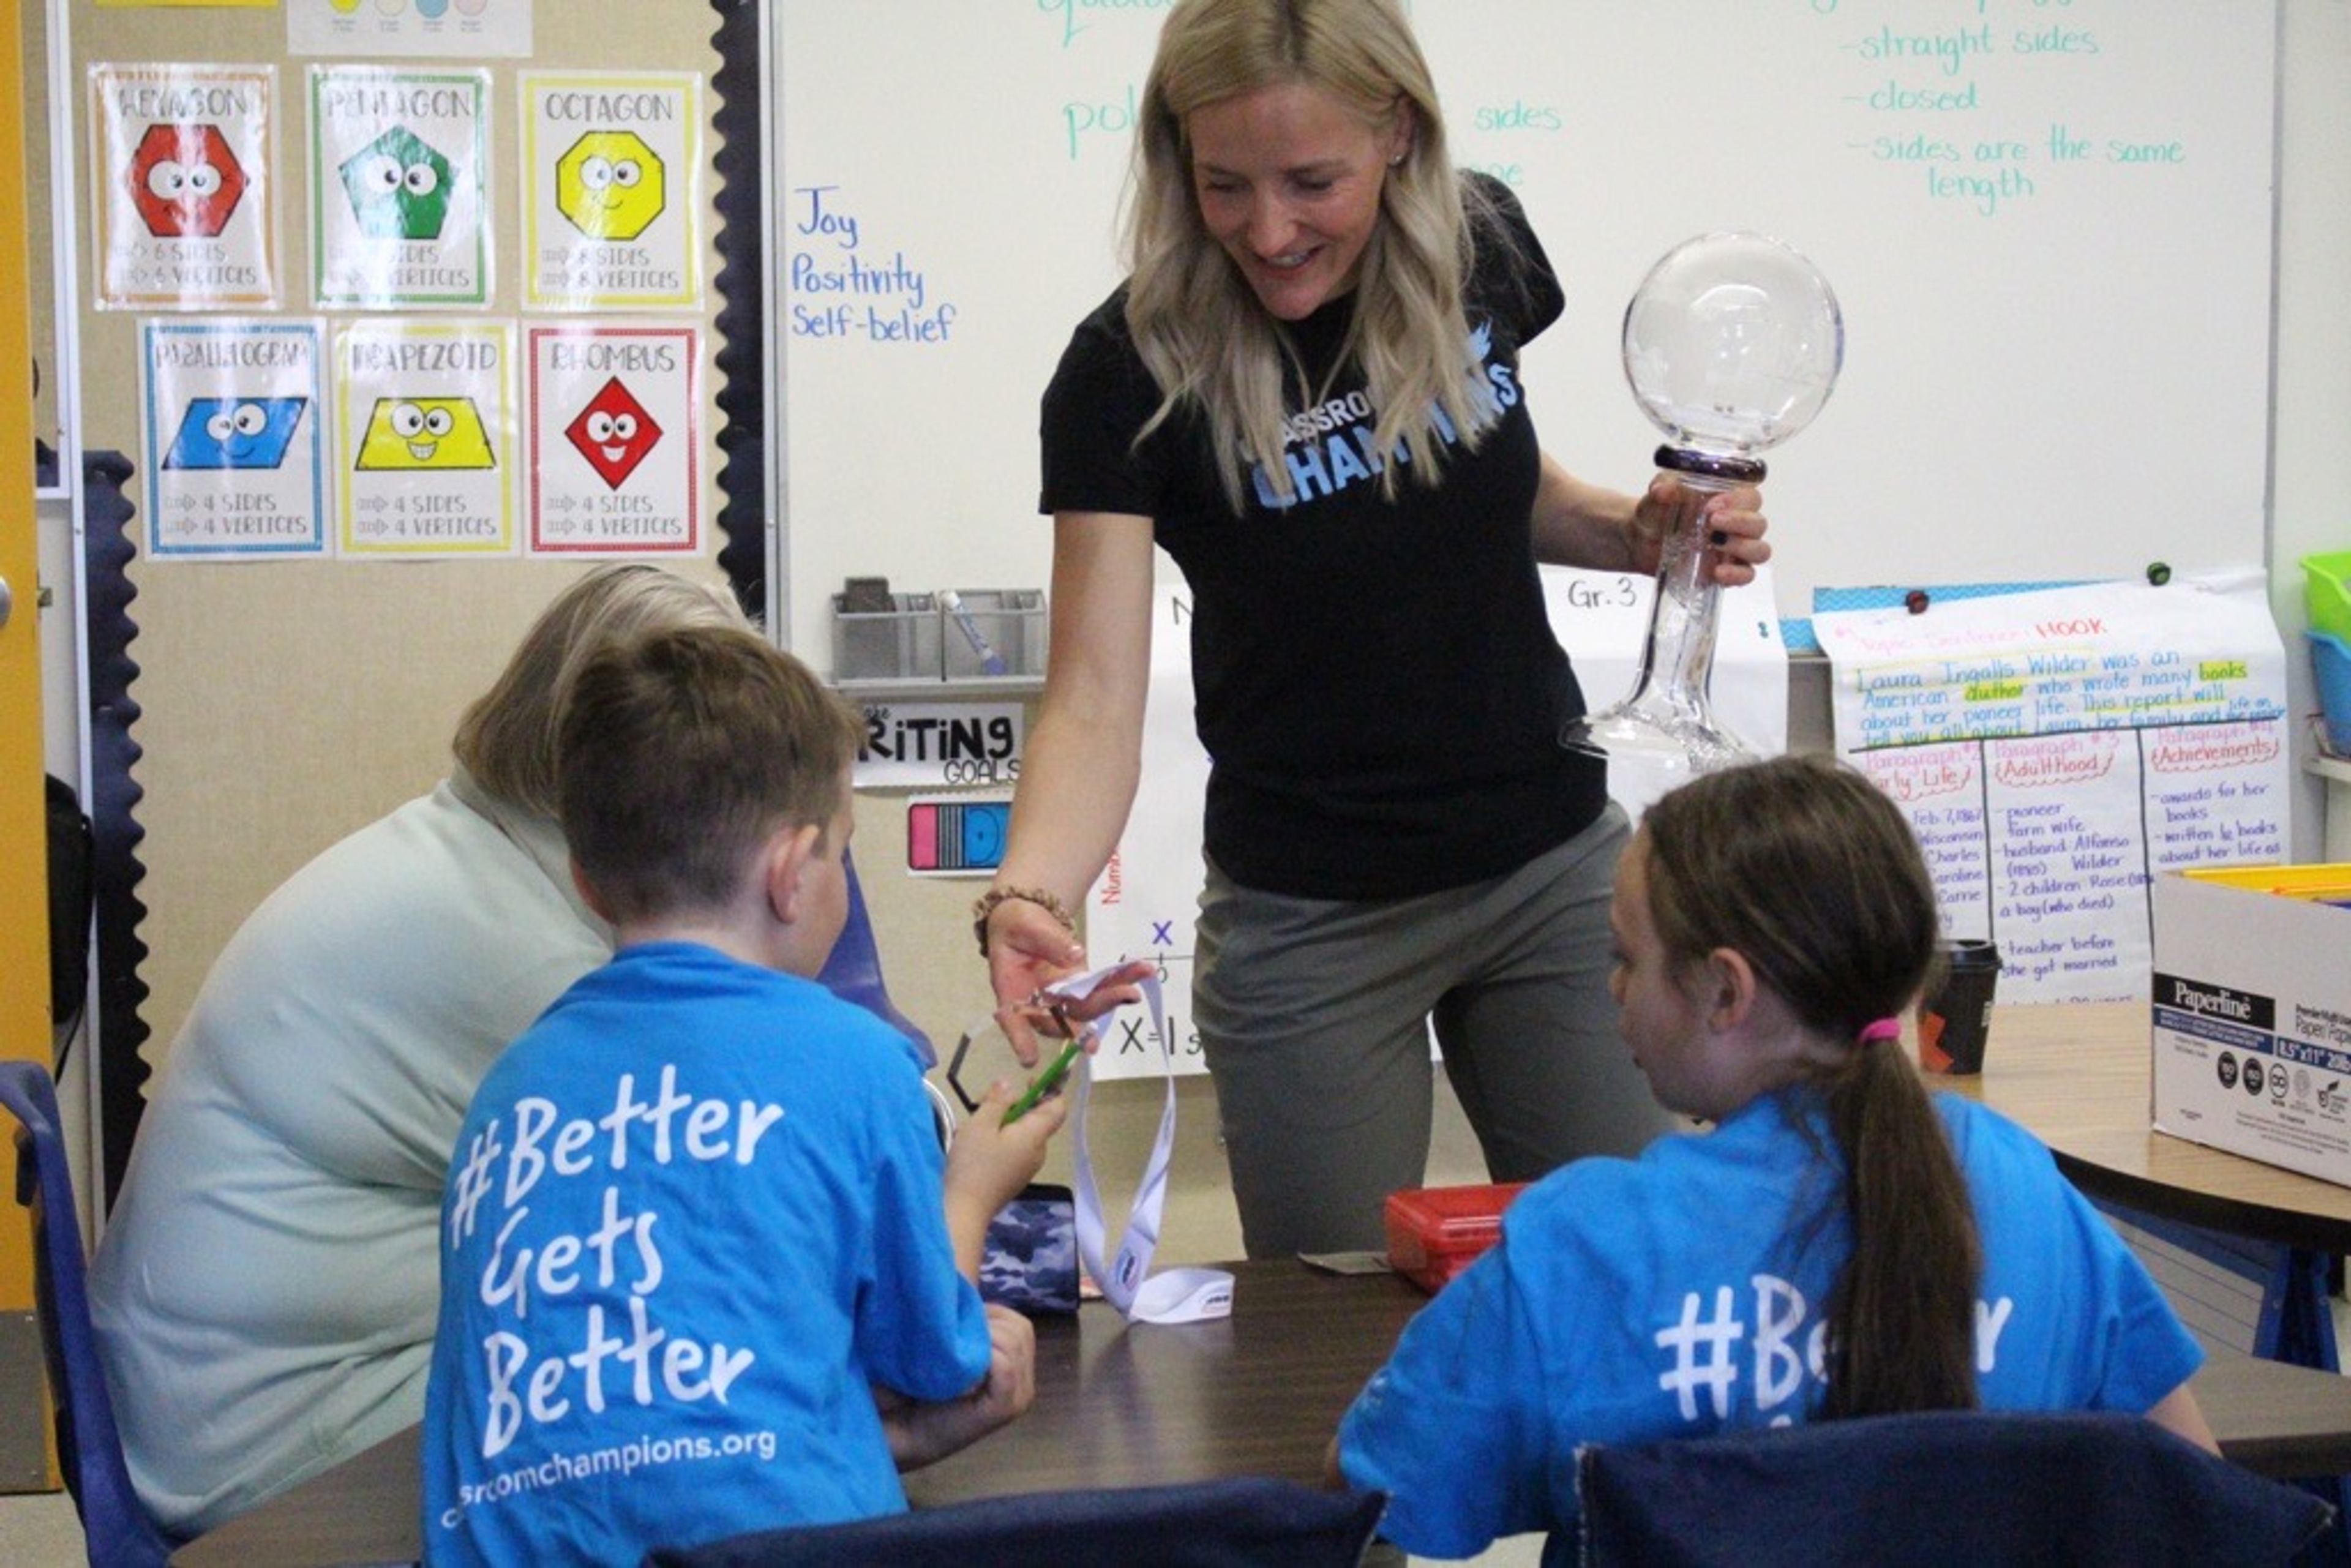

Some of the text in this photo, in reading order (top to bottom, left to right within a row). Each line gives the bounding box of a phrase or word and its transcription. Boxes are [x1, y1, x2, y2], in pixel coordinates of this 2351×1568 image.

[2012, 24, 2100, 54] sides
[546, 92, 672, 121] OCTAGON
[1063, 84, 1562, 160] pol sides
[1973, 139, 2030, 162] are
[2047, 123, 2091, 162] the
[2105, 137, 2186, 163] same
[1929, 167, 2036, 217] length
[794, 186, 858, 249] Joy
[596, 247, 651, 266] SIDES
[597, 270, 679, 289] VERTICES
[792, 252, 923, 309] Positivity
[792, 304, 956, 342] Self-belief
[203, 493, 277, 511] 4 SIDES
[395, 495, 467, 514] 4 SIDES
[583, 495, 653, 514] 4 SIDES
[204, 516, 309, 534] 4 VERTICES
[395, 517, 497, 536] 4 VERTICES
[583, 517, 683, 536] 4 VERTICES
[1618, 577, 1637, 606] 3
[1857, 651, 2180, 692] Laura Ingalls Wilder was an
[1864, 689, 1948, 709] American
[2038, 678, 2072, 694] who
[2083, 672, 2129, 691] wrote
[2142, 669, 2192, 688] many
[2199, 661, 2248, 680] books
[1860, 711, 1911, 730] about
[1922, 709, 1949, 724] her
[1963, 705, 2021, 729] pioneer
[2081, 694, 2115, 711] This
[2124, 687, 2182, 711] report
[2194, 683, 2224, 702] will
[943, 759, 1021, 784] GOALS
[2160, 781, 2268, 805] awards for her
[2006, 804, 2064, 819] pioneer
[2165, 806, 2208, 823] books
[2050, 816, 2084, 833] wife
[2164, 824, 2214, 842] written
[2236, 819, 2278, 836] books
[2004, 838, 2067, 857] husband
[2158, 845, 2200, 863] about
[2206, 844, 2230, 858] her
[2238, 839, 2262, 856] life
[2071, 853, 2123, 871] Wilder
[2009, 881, 2019, 896] 2
[2023, 879, 2081, 895] children
[2000, 906, 2011, 917] a
[2009, 934, 2115, 955] teacher before
[2002, 955, 2118, 980] she got married
[449, 1063, 784, 1249] #Better
[480, 1186, 663, 1319] Gets
[482, 1296, 756, 1458] Better
